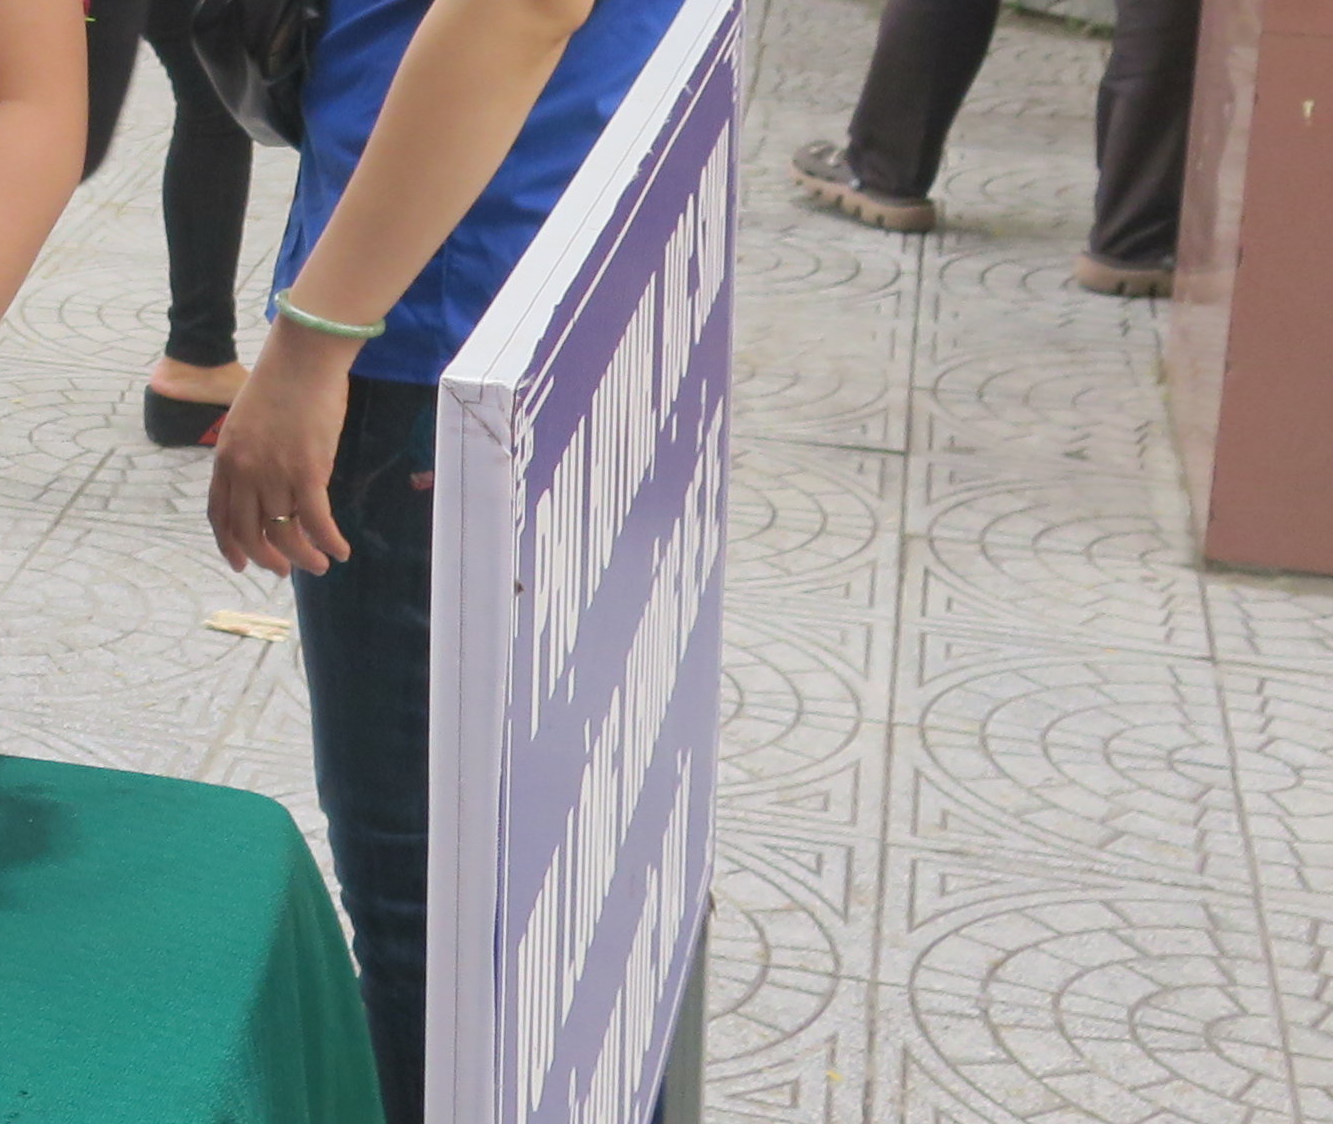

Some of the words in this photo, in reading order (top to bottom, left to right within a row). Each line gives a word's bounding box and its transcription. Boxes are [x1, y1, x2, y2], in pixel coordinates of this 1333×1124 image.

[694, 119, 730, 344] SINH
[562, 686, 619, 1027] LÒNG
[621, 518, 680, 846] KHÔNG
